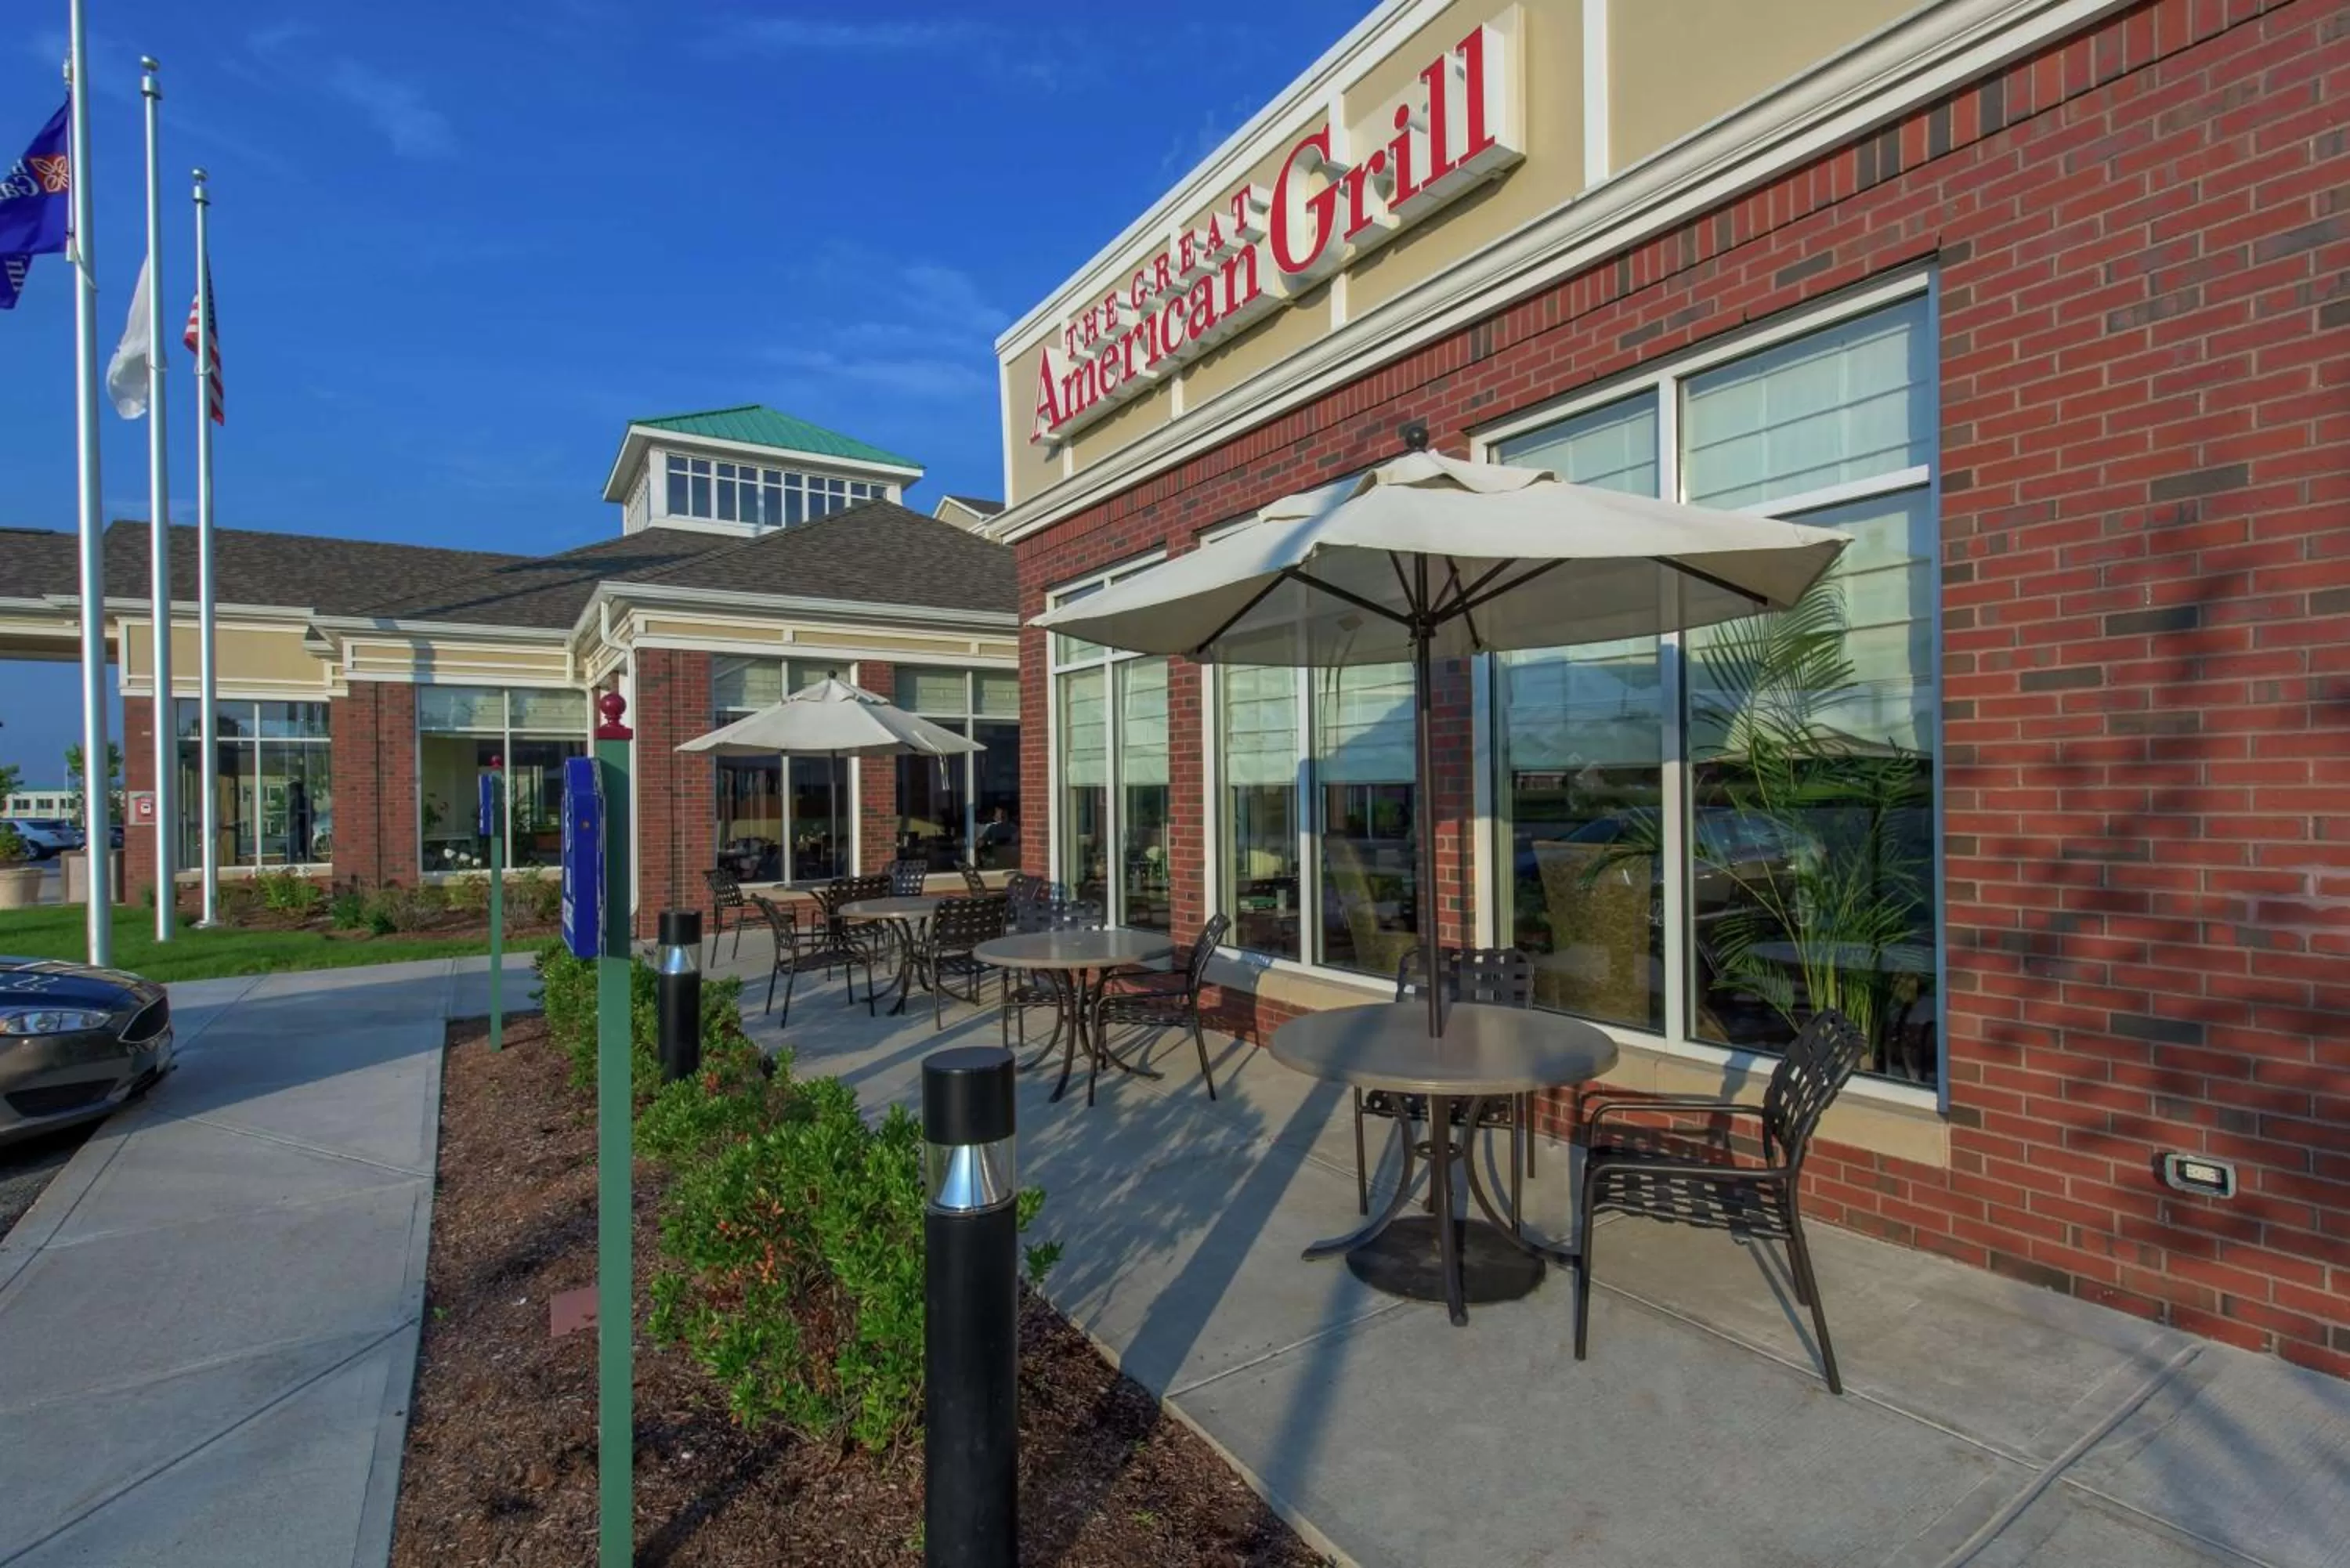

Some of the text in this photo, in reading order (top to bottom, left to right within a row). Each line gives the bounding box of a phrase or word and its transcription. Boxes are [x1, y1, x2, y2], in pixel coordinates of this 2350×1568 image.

[1029, 24, 1495, 444] American Grill
[1065, 185, 1252, 359] THE GREAT
